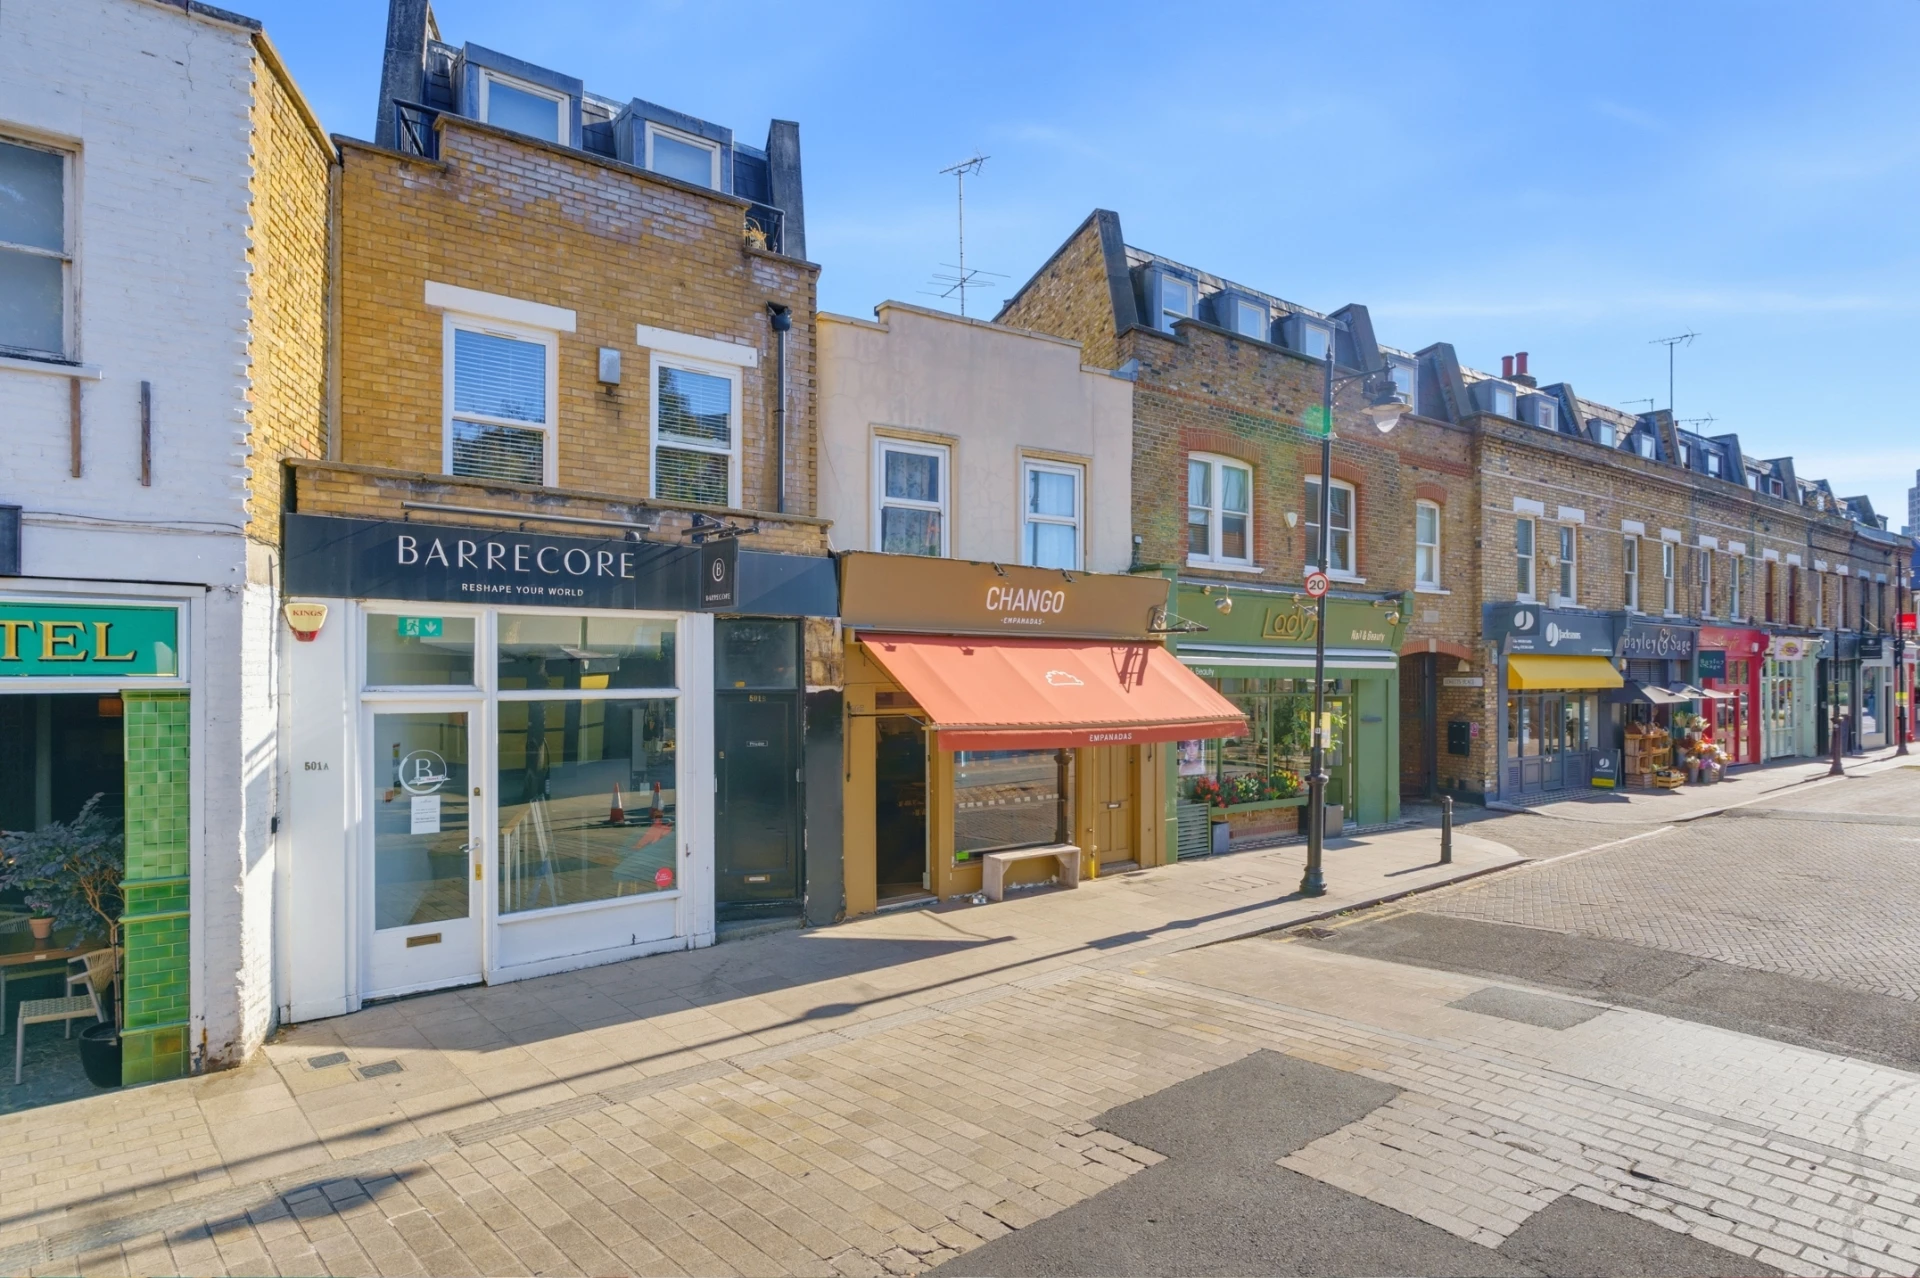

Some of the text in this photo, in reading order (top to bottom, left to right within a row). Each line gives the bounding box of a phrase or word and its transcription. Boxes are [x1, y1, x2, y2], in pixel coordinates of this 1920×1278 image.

[398, 535, 635, 579] BARRECORE
[461, 583, 584, 597] RESHAPE YOUR WORLD
[1309, 580, 1325, 590] 20
[986, 586, 1065, 613] CHANGO
[1367, 630, 1385, 643] Beauty
[1624, 632, 1656, 654] Bayley
[1657, 628, 1671, 656] &
[1670, 634, 1691, 655] Sage
[1089, 733, 1132, 742] EMPANADAS
[304, 761, 329, 771] 501A
